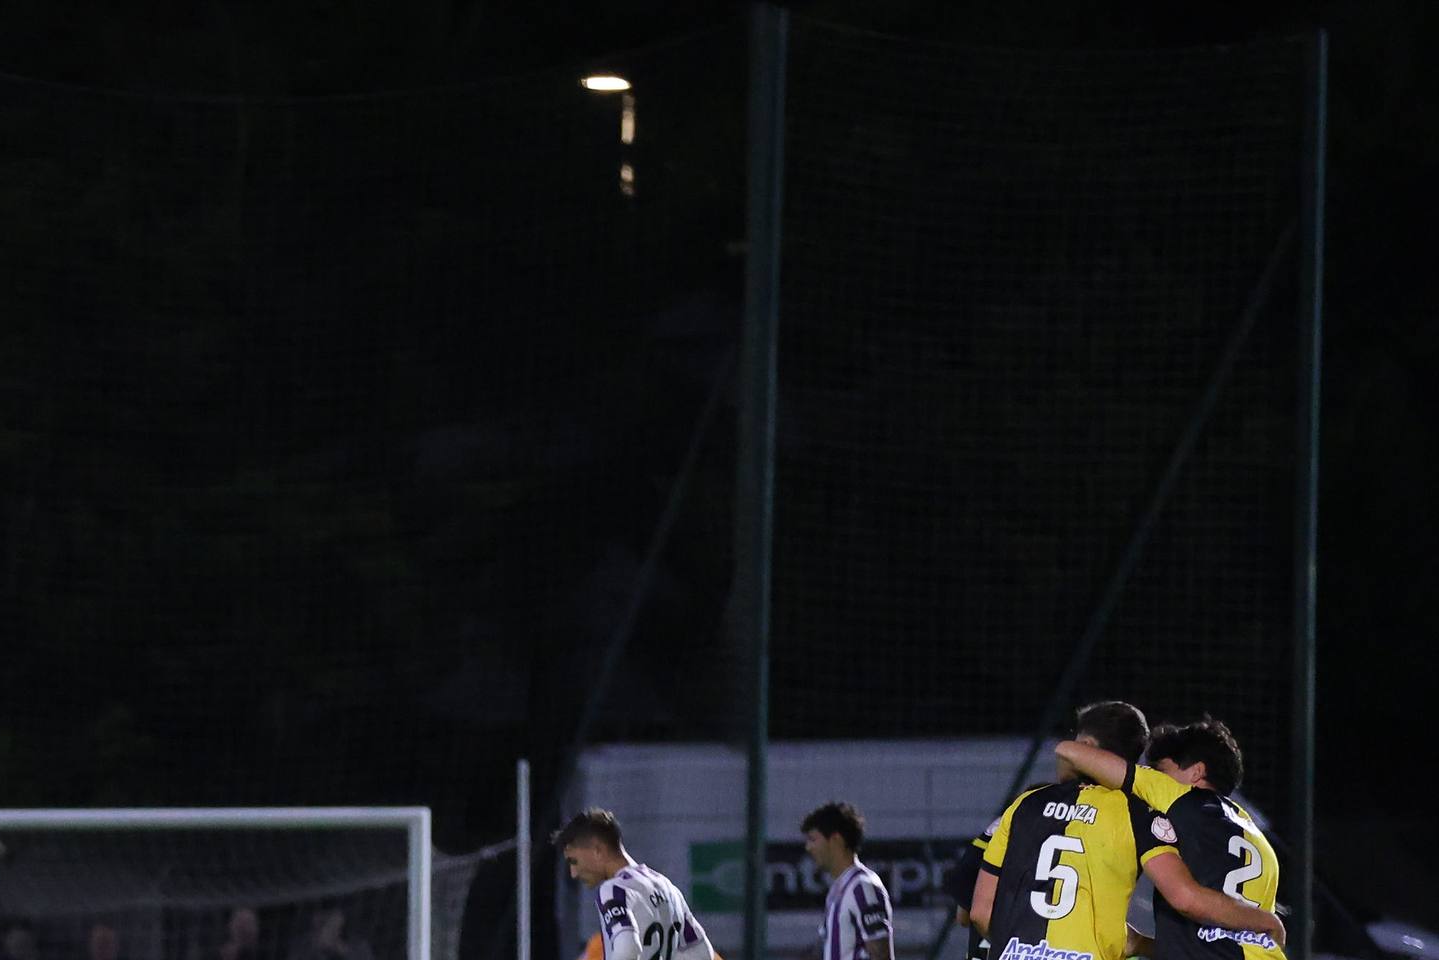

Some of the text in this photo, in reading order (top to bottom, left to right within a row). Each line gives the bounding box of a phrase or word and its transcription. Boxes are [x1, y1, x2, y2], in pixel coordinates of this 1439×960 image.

[1042, 801, 1099, 825] GONZA
[1029, 834, 1085, 920] 5
[1222, 834, 1263, 909] 2
